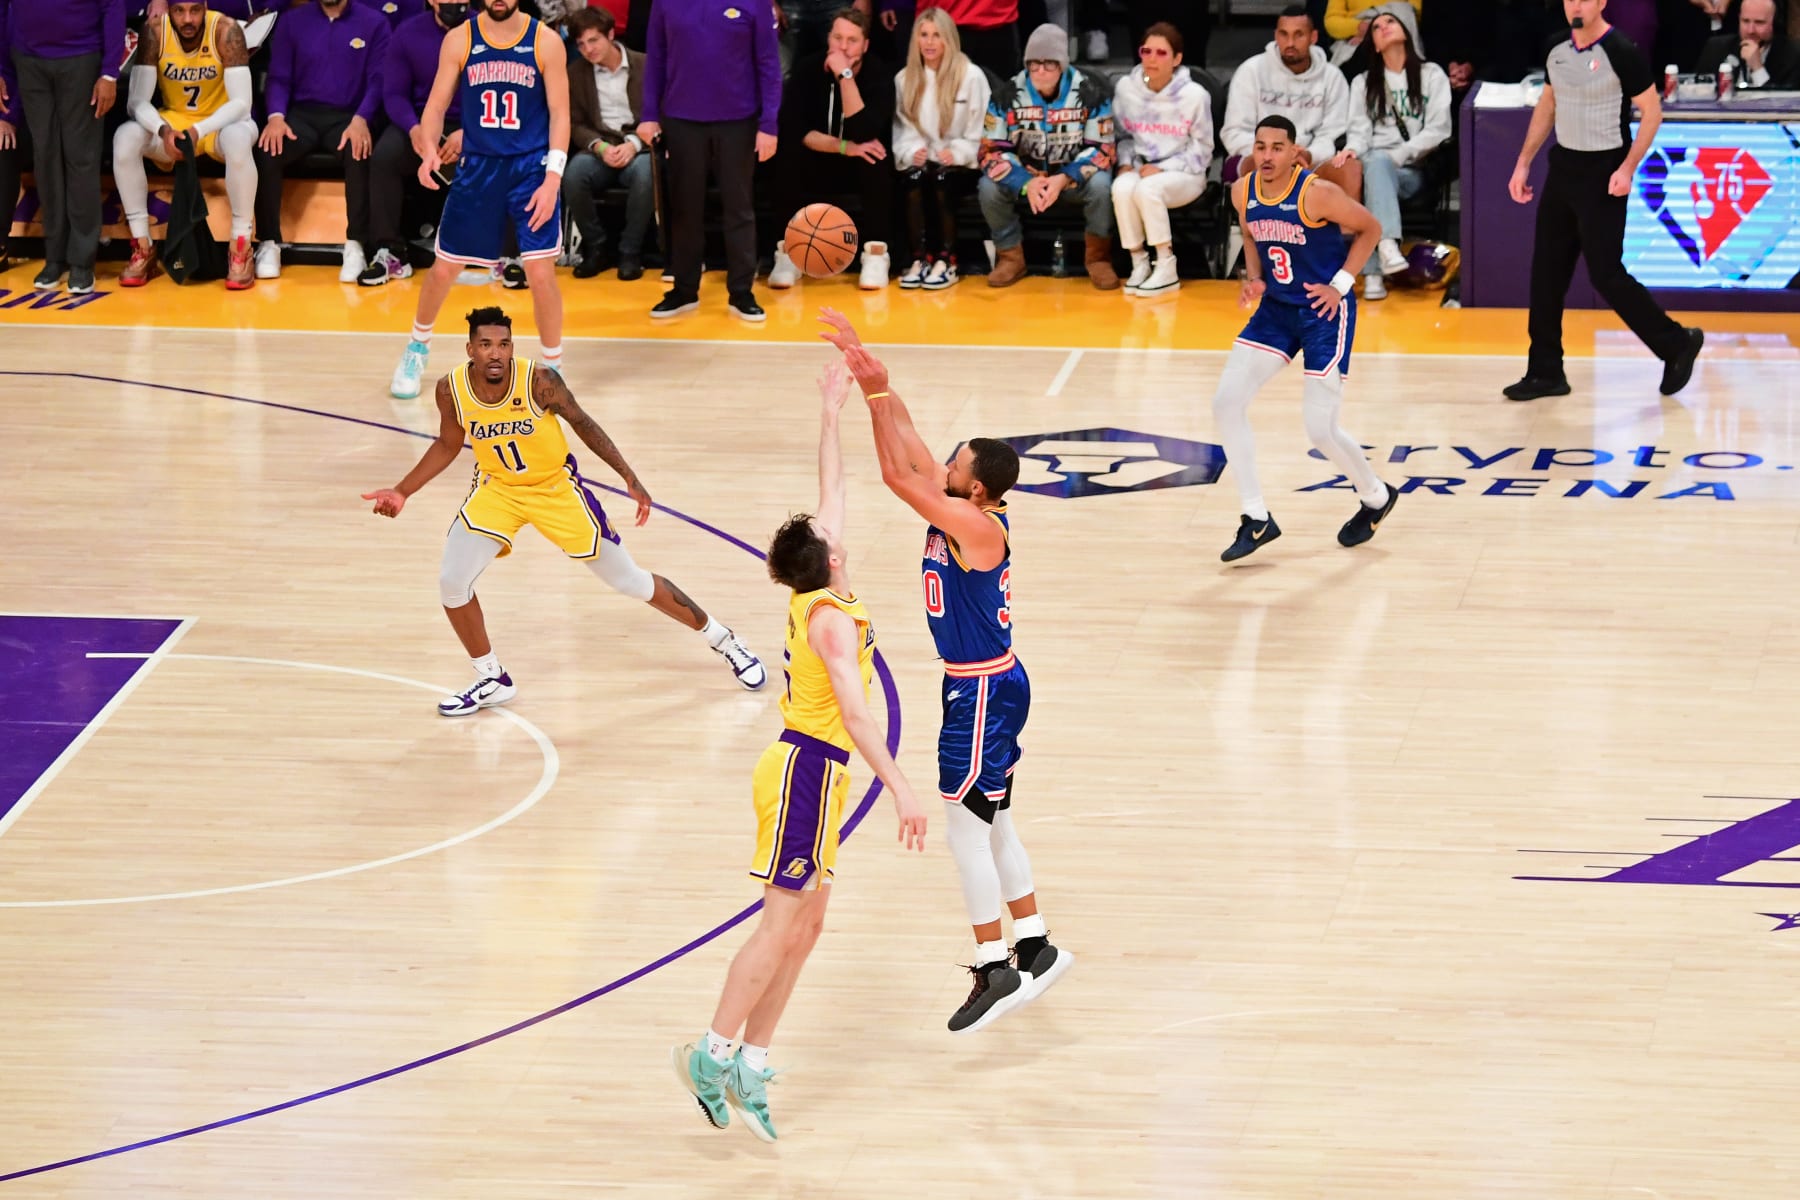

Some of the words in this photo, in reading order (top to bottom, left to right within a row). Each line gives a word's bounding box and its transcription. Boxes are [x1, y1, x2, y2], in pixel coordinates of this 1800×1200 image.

[163, 62, 218, 81] LAKERS
[466, 60, 536, 89] WARRIORS
[183, 85, 201, 111] 7
[480, 89, 520, 130] 11
[1714, 163, 1744, 201] 75
[1268, 246, 1294, 285] 3
[469, 418, 534, 441] LAKERS
[493, 440, 528, 475] 11
[1293, 474, 1736, 501] ARENA
